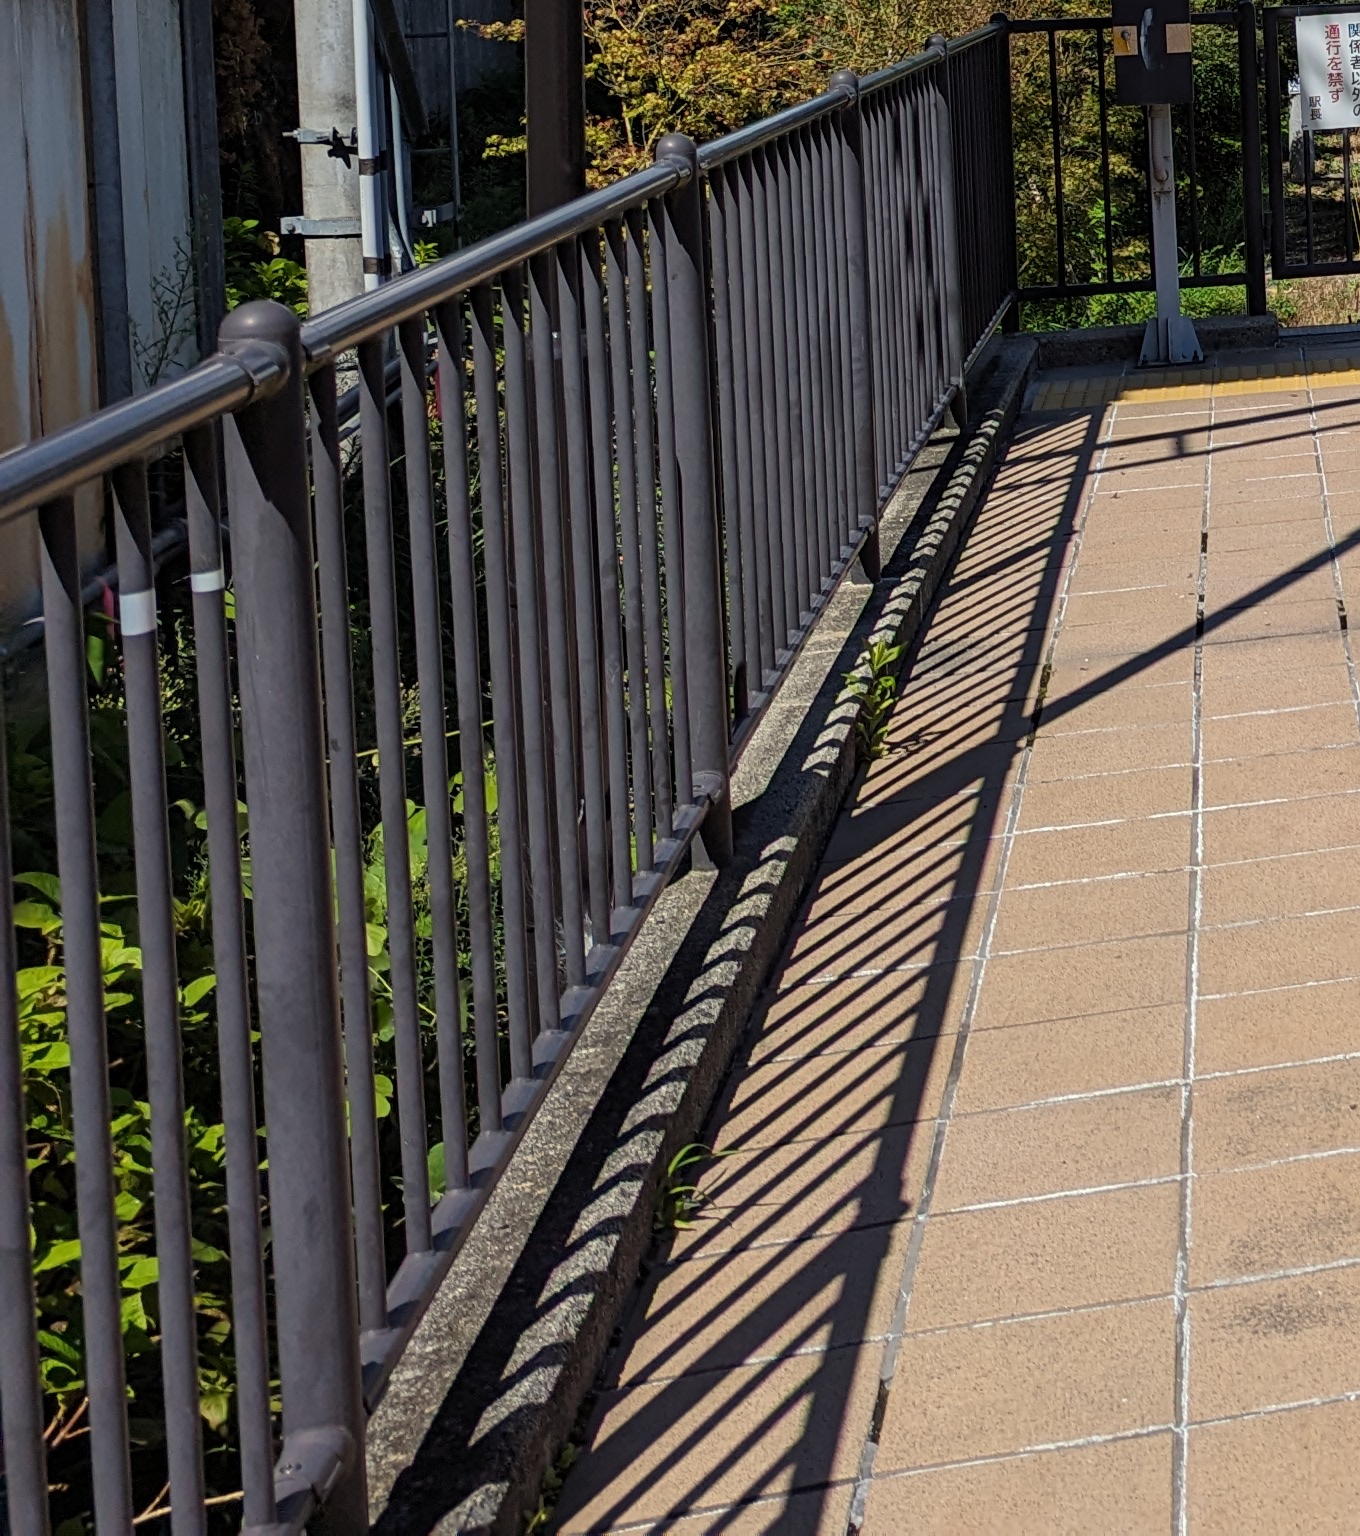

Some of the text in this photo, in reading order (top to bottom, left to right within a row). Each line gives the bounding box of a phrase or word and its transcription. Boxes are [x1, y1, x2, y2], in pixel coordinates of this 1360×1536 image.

[1324, 23, 1345, 104] 通行を禁ず
[1308, 95, 1323, 121] 駅長
